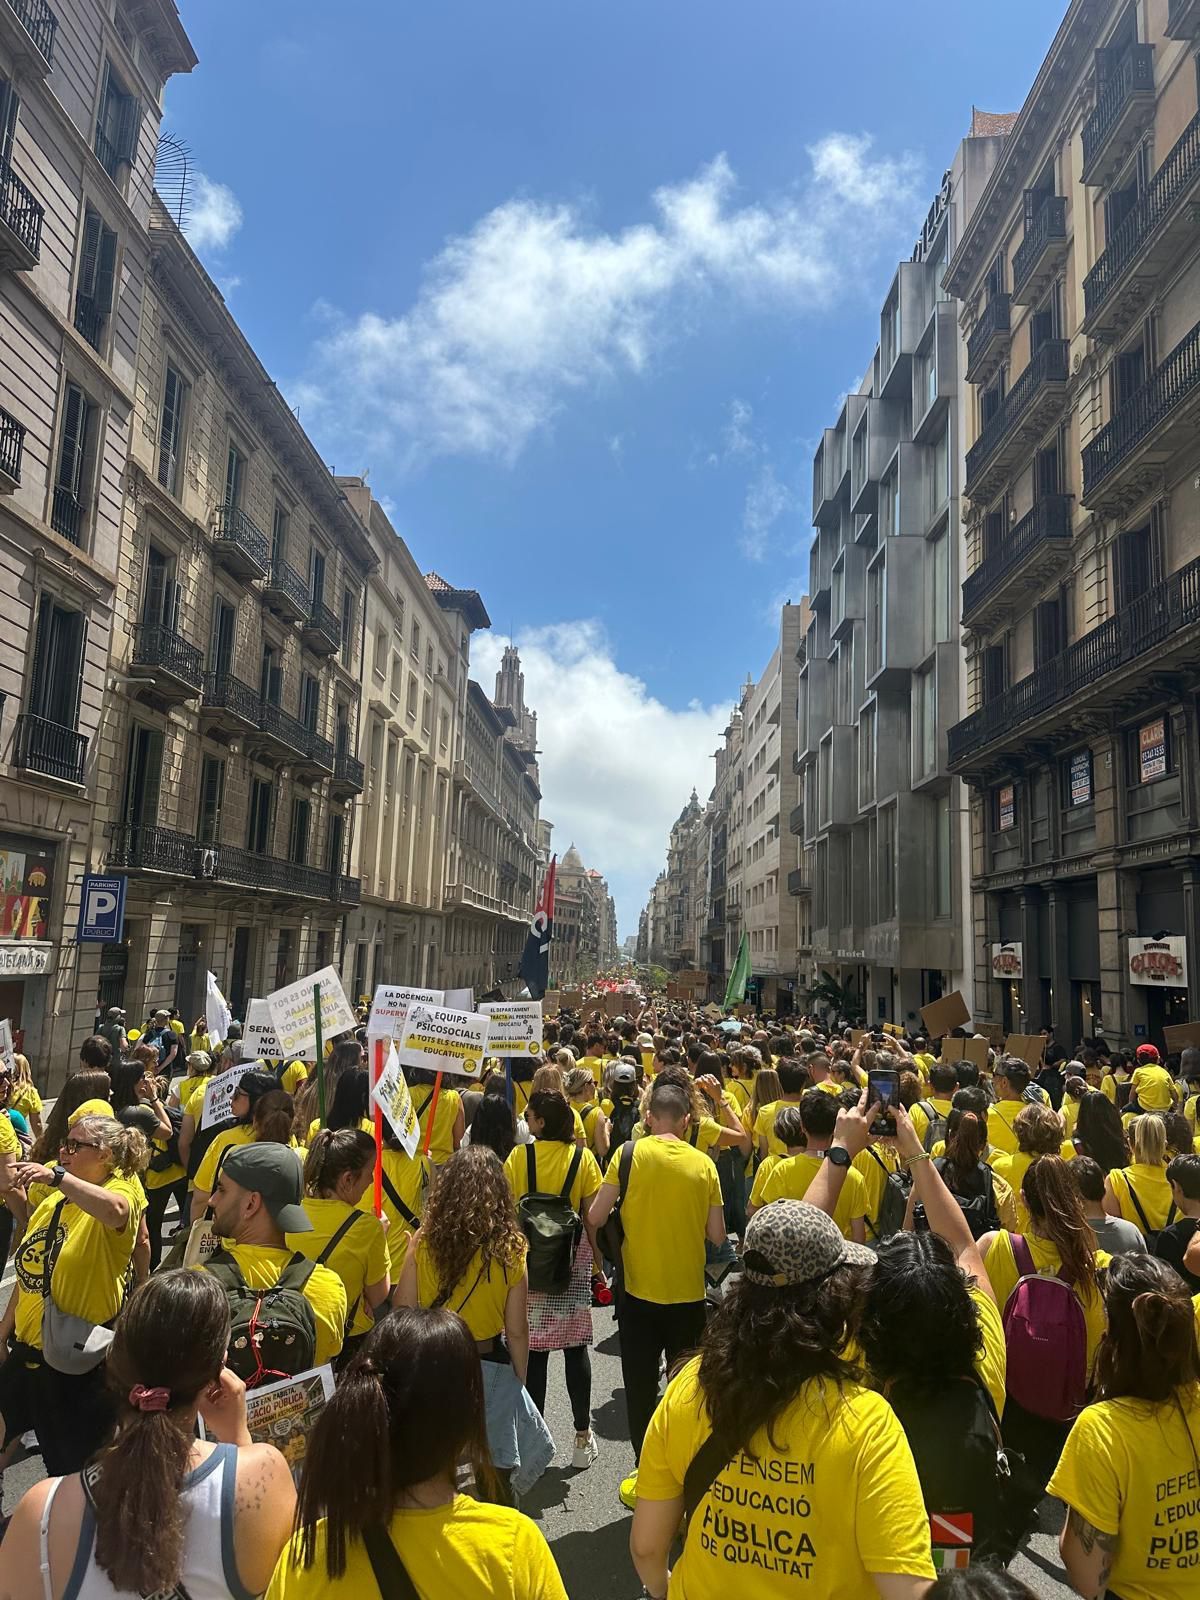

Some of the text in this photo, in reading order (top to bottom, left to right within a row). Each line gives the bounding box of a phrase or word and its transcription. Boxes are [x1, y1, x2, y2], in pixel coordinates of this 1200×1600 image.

[87, 891, 116, 926] P
[838, 950, 865, 958] Hotel
[376, 1009, 408, 1018] SUPERVI
[435, 1012, 468, 1025] EQUIPS
[249, 1025, 276, 1034] SENS
[416, 1022, 481, 1040] PSICOSOCIALS
[417, 1035, 436, 1044] TOTS
[450, 1040, 483, 1052] CENTRES
[424, 1047, 465, 1059] EDUCATIUS
[727, 1452, 815, 1485] FENSEM
[708, 1481, 811, 1518] EDUCACIÓ
[703, 1505, 817, 1557] PÚBLICA
[701, 1532, 814, 1580] DE QUALITAT
[1146, 1553, 1200, 1570] DE QU
